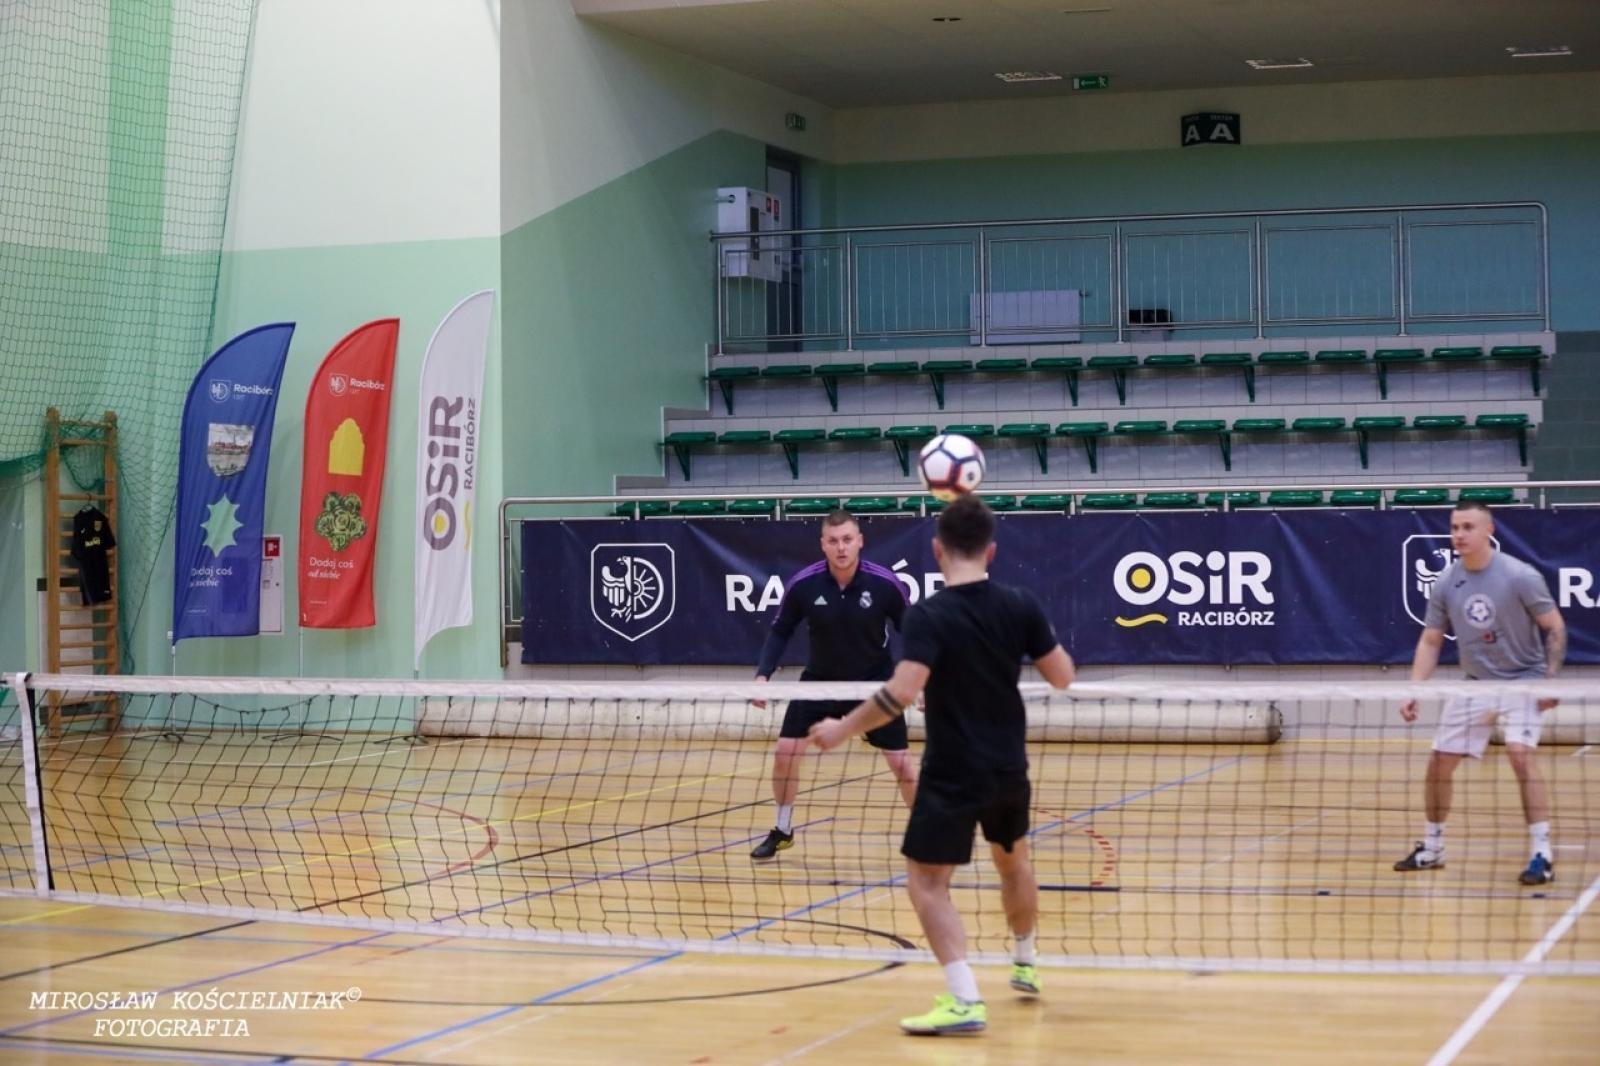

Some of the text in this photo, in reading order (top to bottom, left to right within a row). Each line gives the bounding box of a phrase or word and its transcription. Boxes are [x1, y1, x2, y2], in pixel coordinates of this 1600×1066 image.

[1185, 124, 1201, 143] A
[1209, 122, 1235, 141] A
[464, 397, 476, 490] RACIBÓRZ
[1113, 550, 1275, 606] OSiR
[1178, 607, 1275, 626] RACIBÓRZ
